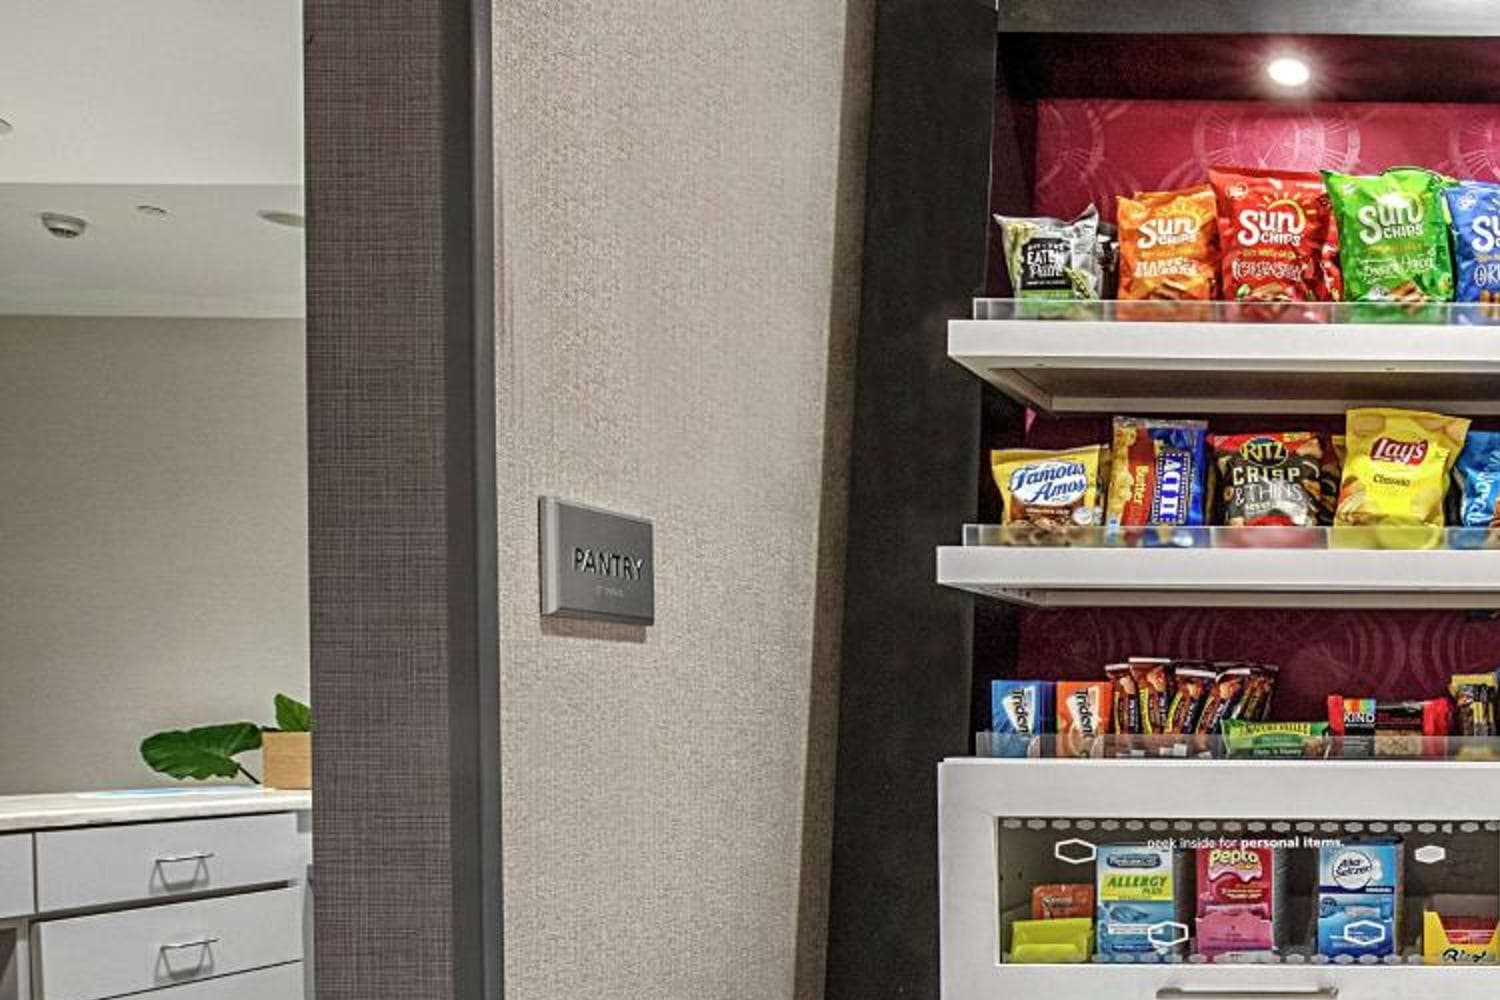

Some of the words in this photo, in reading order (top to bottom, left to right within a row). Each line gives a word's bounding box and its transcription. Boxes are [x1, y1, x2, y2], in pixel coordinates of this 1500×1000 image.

[1238, 209, 1304, 247] Sun
[1358, 192, 1424, 246] Sun
[1382, 223, 1424, 240] CHIPS
[1241, 441, 1286, 461] RITZ
[1372, 437, 1427, 465] Lay's
[1010, 462, 1087, 492] Famous
[1233, 466, 1301, 485] CRISP
[1027, 476, 1086, 503] Amos
[574, 547, 644, 581] PANTRY
[1011, 688, 1031, 738] Trident
[1075, 687, 1096, 739] Trident
[1343, 711, 1375, 723] KIND
[1148, 837, 1176, 850] peek
[1180, 837, 1217, 849] inside
[1219, 837, 1238, 849] for
[1241, 837, 1299, 851] personal
[1303, 836, 1345, 849] items.
[1107, 875, 1167, 888] ALLERGY
